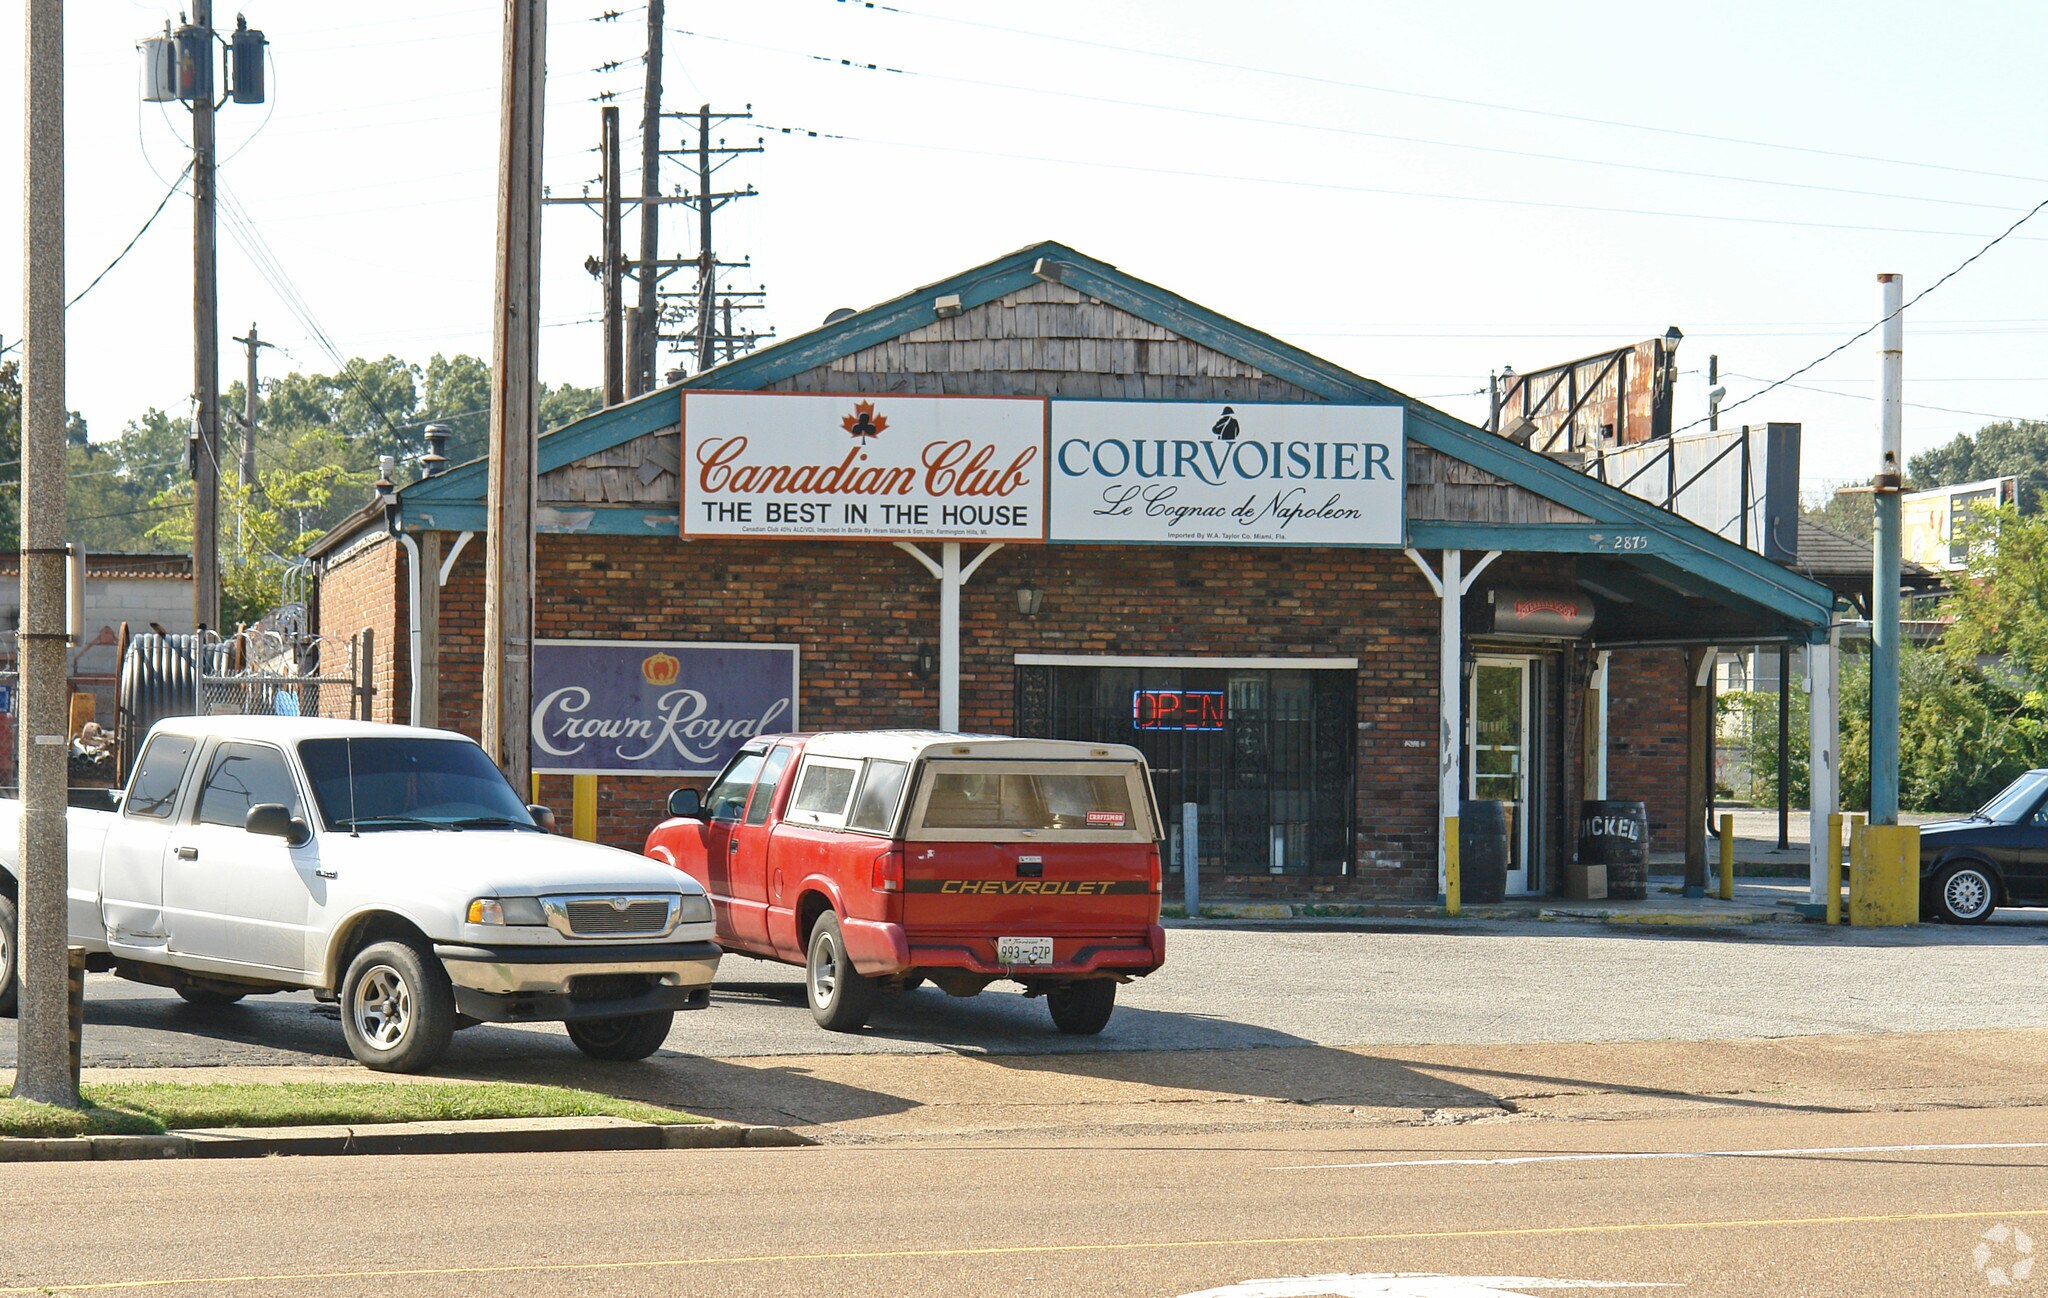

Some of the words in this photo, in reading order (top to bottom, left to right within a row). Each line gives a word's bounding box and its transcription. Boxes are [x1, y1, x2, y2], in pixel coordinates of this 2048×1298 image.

[697, 436, 915, 496] Canadian
[921, 440, 1038, 497] Club
[1058, 438, 1395, 486] COURVOISIER
[701, 501, 752, 522] THE
[766, 502, 832, 524] BEST
[844, 503, 867, 524] IN
[880, 504, 929, 525] THE
[942, 505, 1028, 526] HOUSE
[1093, 484, 1141, 517] Le
[1143, 484, 1226, 527] Cognac
[1231, 494, 1256, 525] de
[1258, 487, 1361, 529] Napoleon
[1168, 532, 1195, 540] Imported
[1197, 532, 1205, 540] By
[1222, 532, 1240, 540] Taylor
[1614, 535, 1648, 550] 2875
[532, 686, 654, 756] Crown
[616, 689, 790, 764] Royal
[1135, 693, 1224, 727] OPEN
[940, 880, 1116, 895] CHEVROLET
